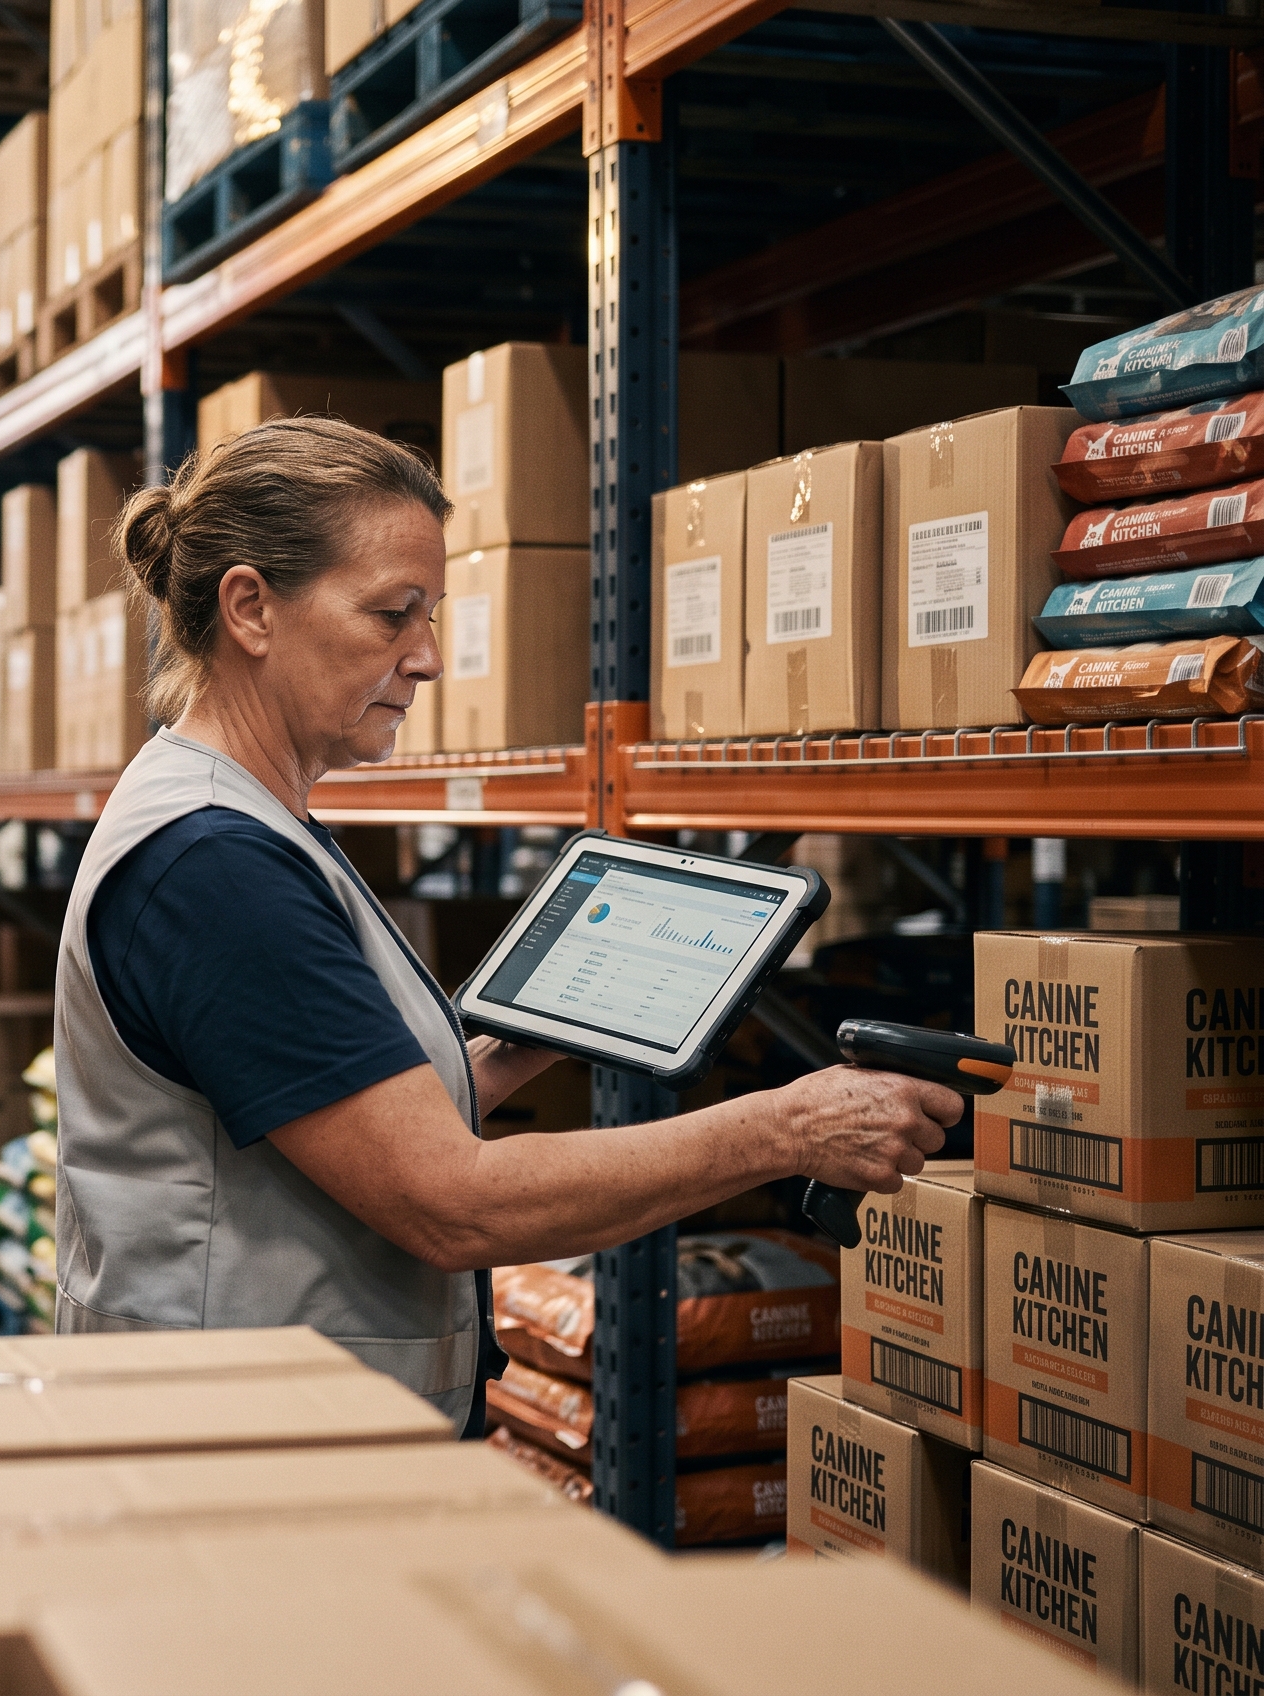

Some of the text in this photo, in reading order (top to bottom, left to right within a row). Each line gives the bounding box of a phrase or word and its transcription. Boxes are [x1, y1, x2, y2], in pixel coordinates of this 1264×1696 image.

[1111, 522, 1161, 542] KITCHEN
[1095, 597, 1145, 613] KITCHEN
[1073, 674, 1123, 689] KITCHEN
[1004, 978, 1099, 1029] CANINE
[1004, 1023, 1100, 1074] KITCHEN
[865, 1207, 943, 1265] CANINE
[865, 1247, 944, 1307] KITCHEN
[1013, 1251, 1108, 1317] CANINE
[1013, 1296, 1108, 1363] KITCHEN
[1186, 1294, 1264, 1360] CANI
[811, 1424, 886, 1492] CANINE
[811, 1464, 886, 1533] KITCHEN
[1001, 1518, 1097, 1599] CANINE
[1001, 1562, 1098, 1645] KITCHEN
